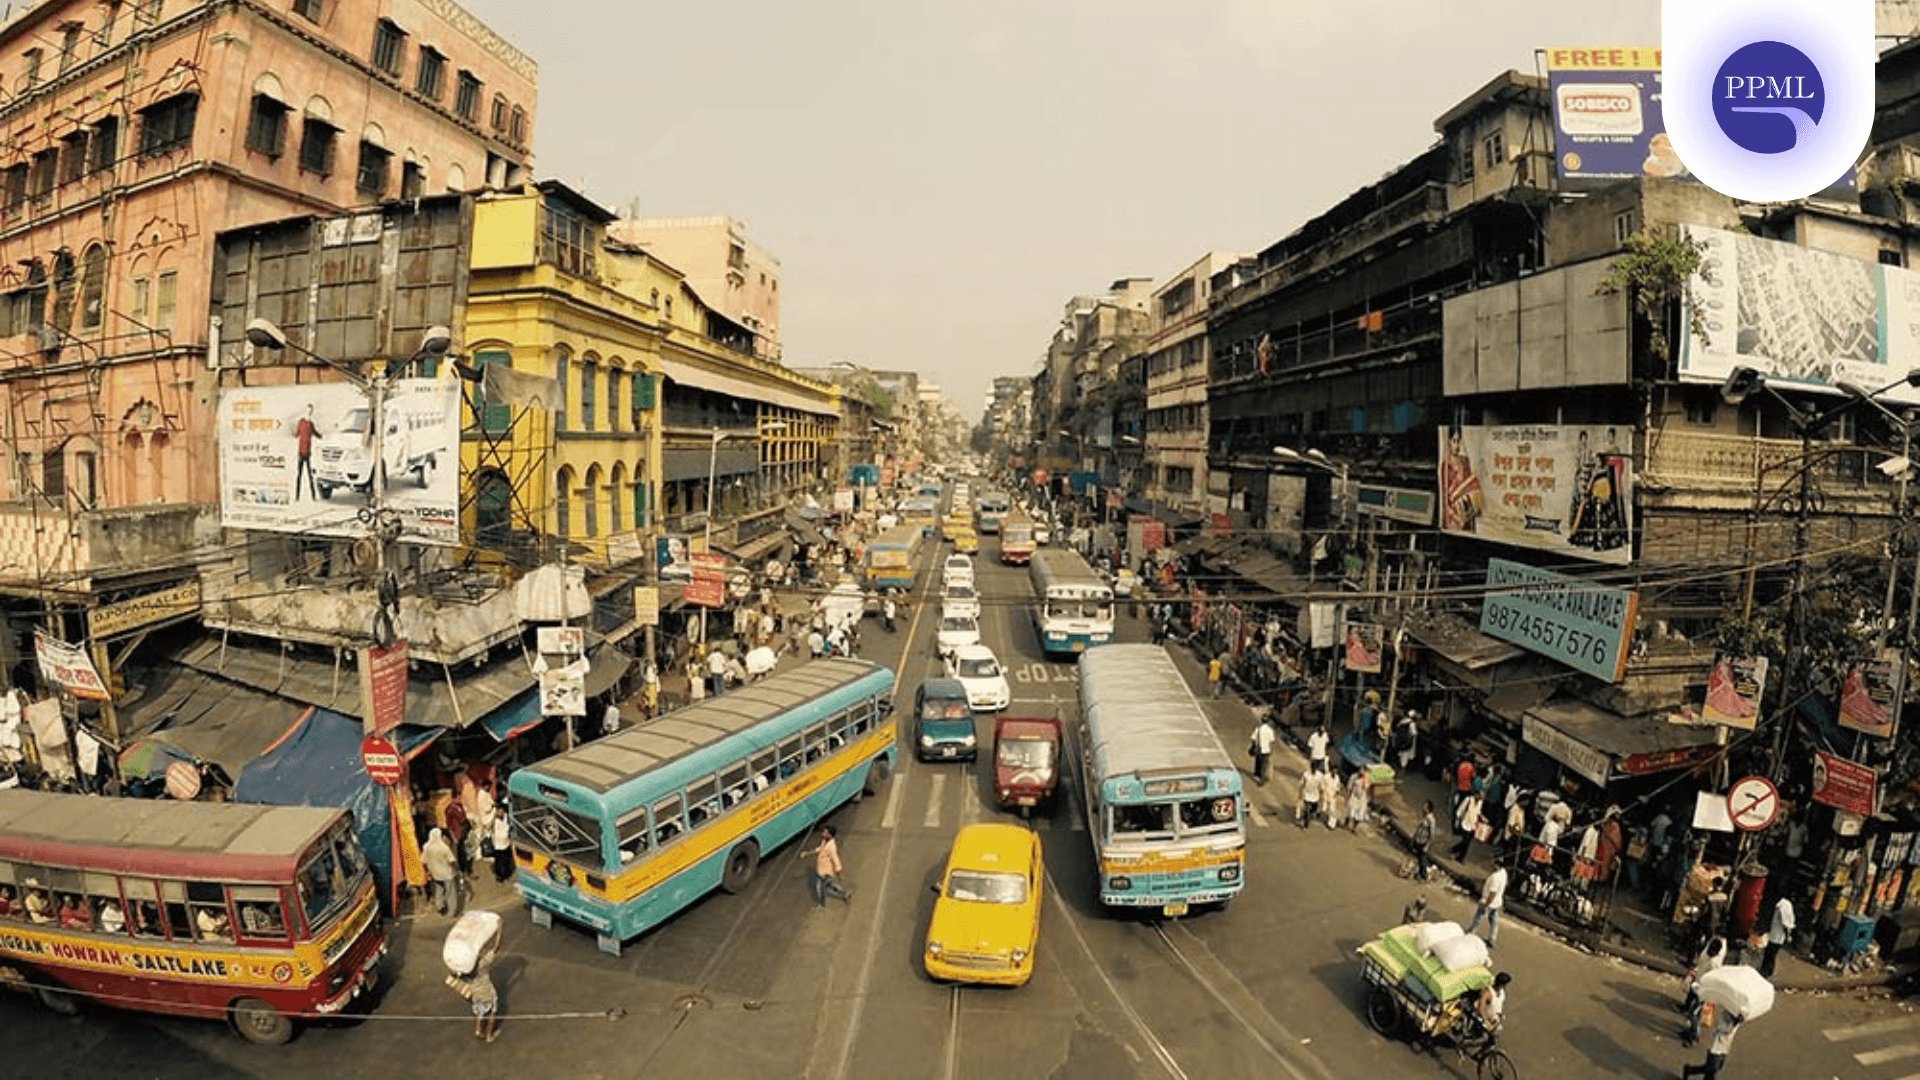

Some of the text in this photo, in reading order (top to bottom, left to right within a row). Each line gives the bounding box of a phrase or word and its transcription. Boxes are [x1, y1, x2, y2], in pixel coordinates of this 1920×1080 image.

[1488, 603, 1607, 665] 9874557576
[51, 942, 122, 966] HOWRAH
[133, 953, 228, 976] SALTLAKE
